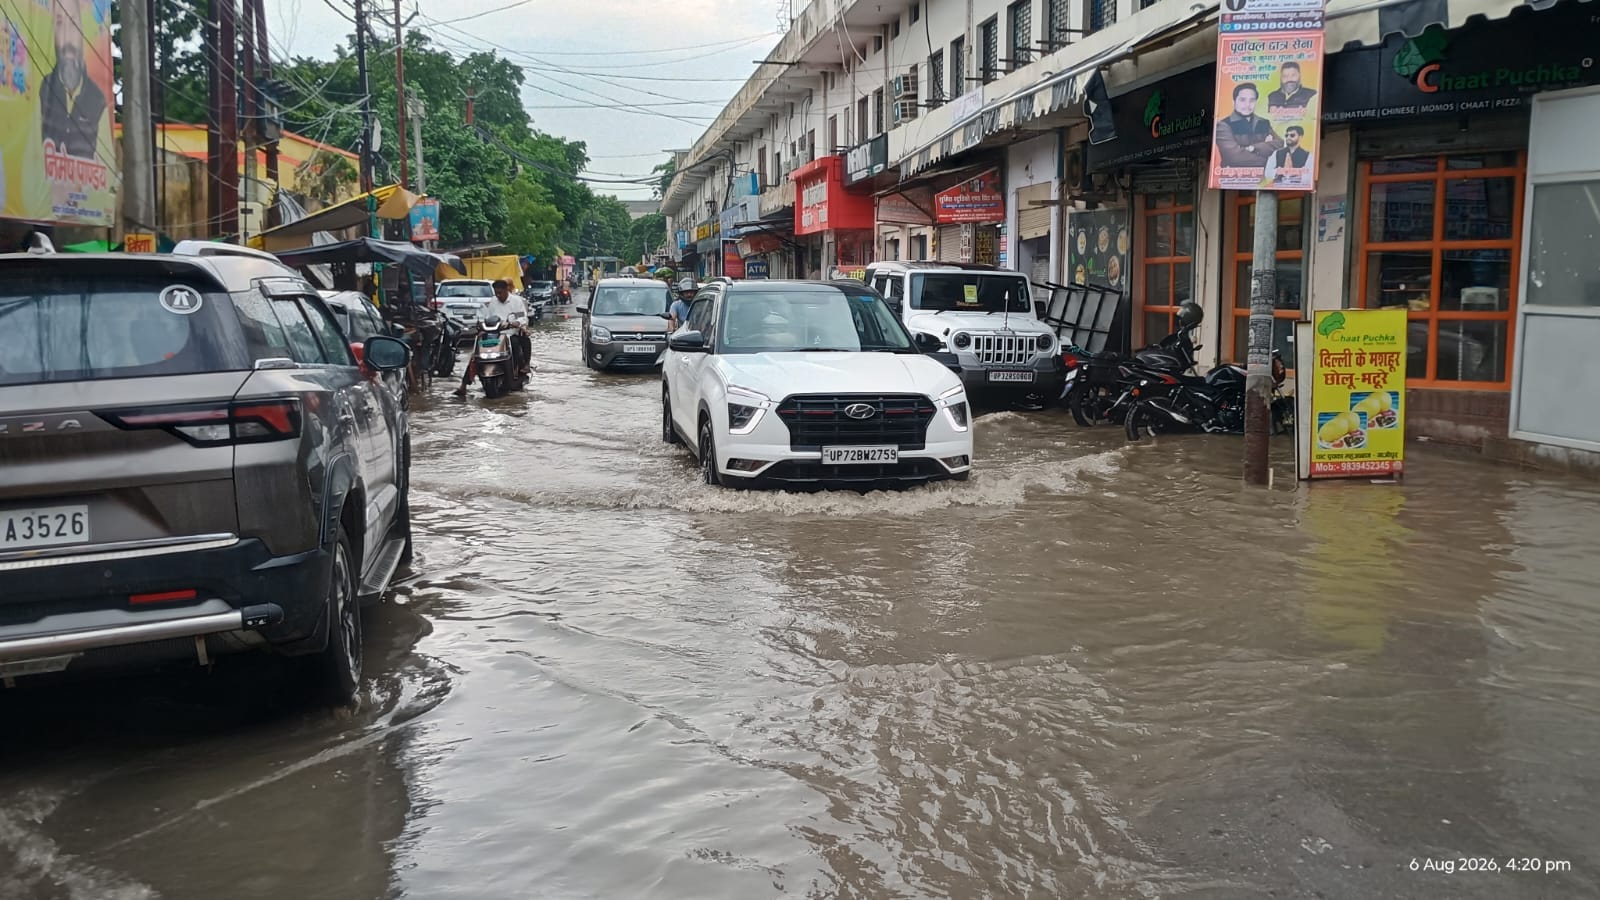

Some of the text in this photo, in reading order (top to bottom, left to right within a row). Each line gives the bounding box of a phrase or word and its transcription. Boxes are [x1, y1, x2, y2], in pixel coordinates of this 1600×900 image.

[1233, 21, 1322, 31] 9838800604
[1269, 41, 1288, 51] छात्र
[1293, 39, 1313, 50] सेना
[1417, 64, 1488, 93] Chaat
[1495, 64, 1581, 86] Puchka
[1340, 109, 1377, 120] BHATURE
[1381, 106, 1415, 117] CHINESE
[1421, 103, 1454, 113] MOMOS
[1460, 100, 1490, 110] CHAAT
[1176, 113, 1201, 132] Puchka
[748, 265, 767, 274] ATM
[1331, 330, 1395, 342] Chaat Puchka
[1319, 348, 1401, 373] दिल्ली के मशहूर
[830, 449, 897, 462] UP72BW2759
[1315, 461, 1390, 472] Mob:- 9839452345
[5, 512, 84, 541] A3526
